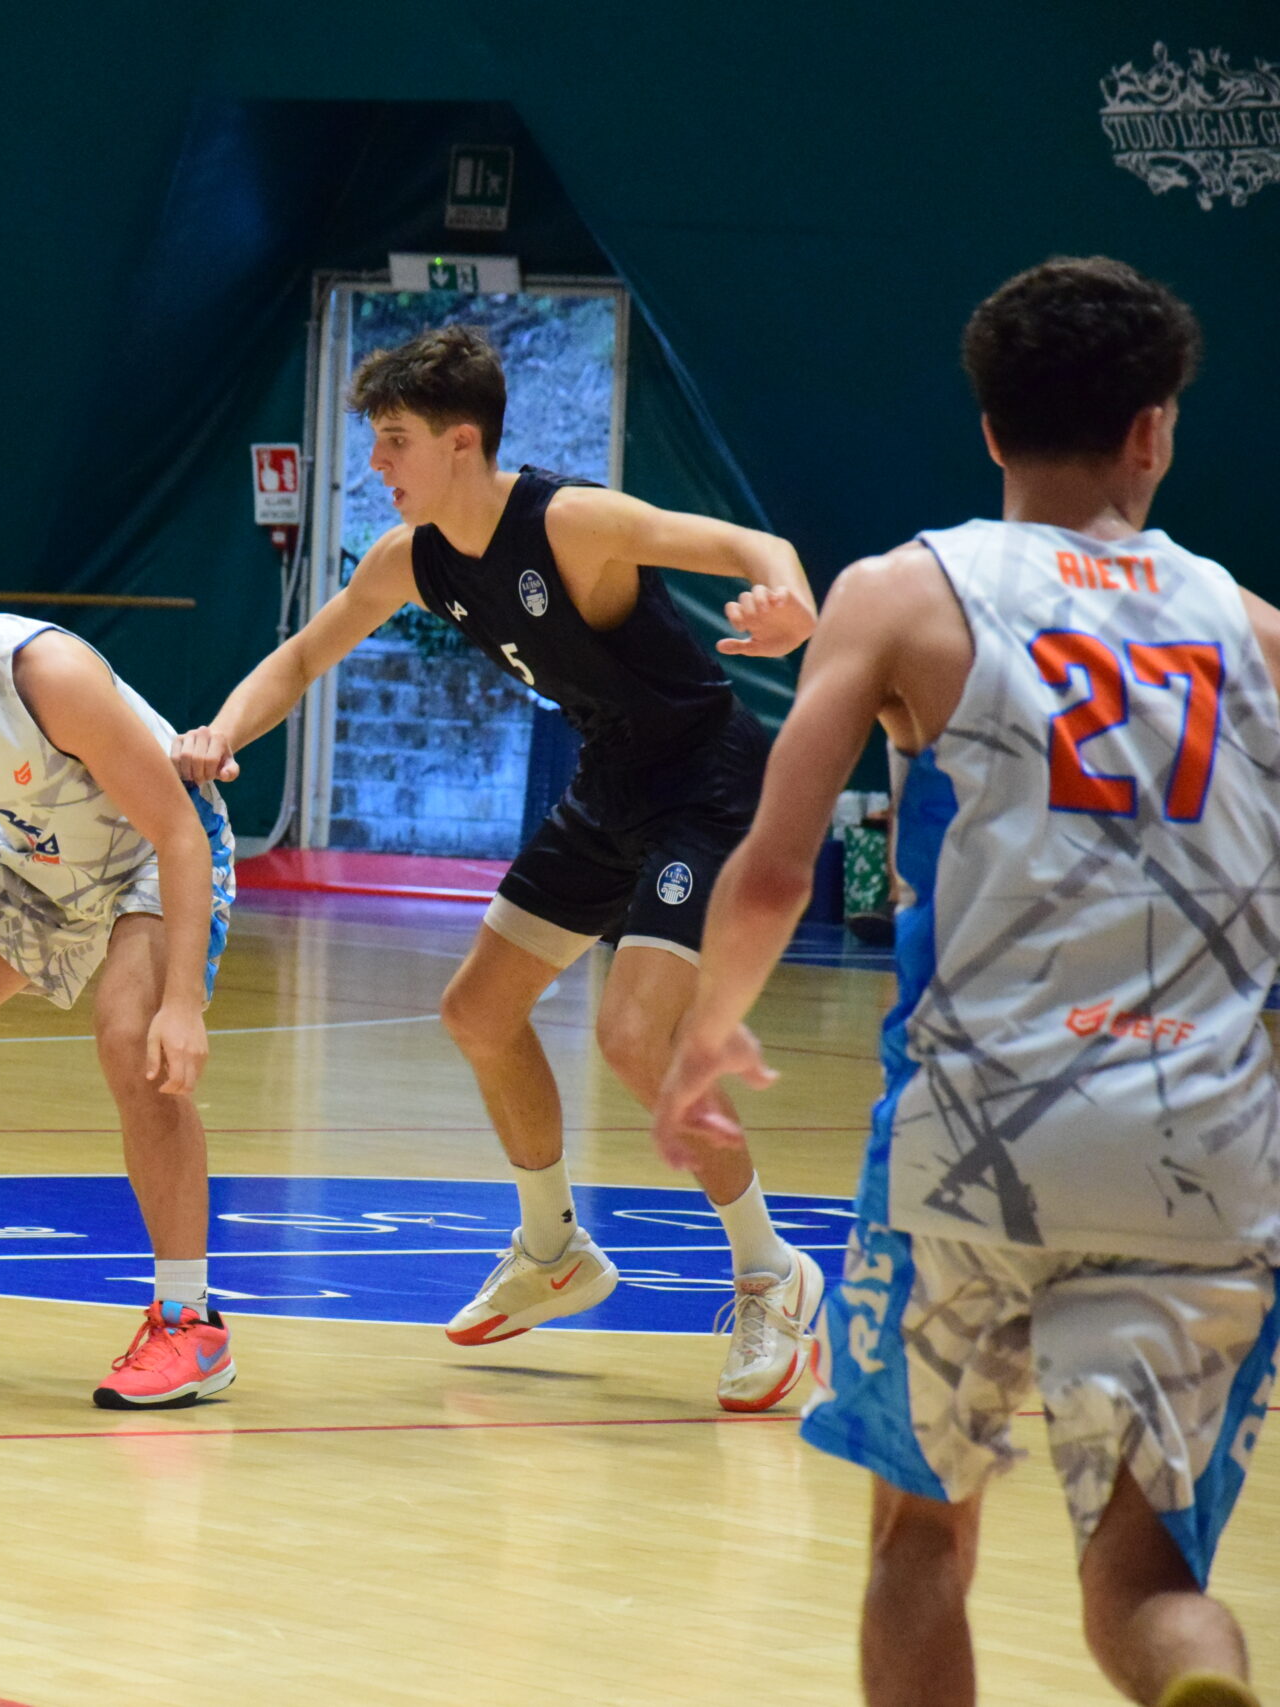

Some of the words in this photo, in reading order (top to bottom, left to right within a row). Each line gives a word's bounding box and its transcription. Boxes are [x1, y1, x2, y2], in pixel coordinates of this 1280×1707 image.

[1101, 115, 1176, 150] STUDIO
[1176, 111, 1258, 147] LEGALE
[1056, 550, 1160, 595] RIETI
[500, 643, 535, 686] 5
[1027, 627, 1226, 824] 27
